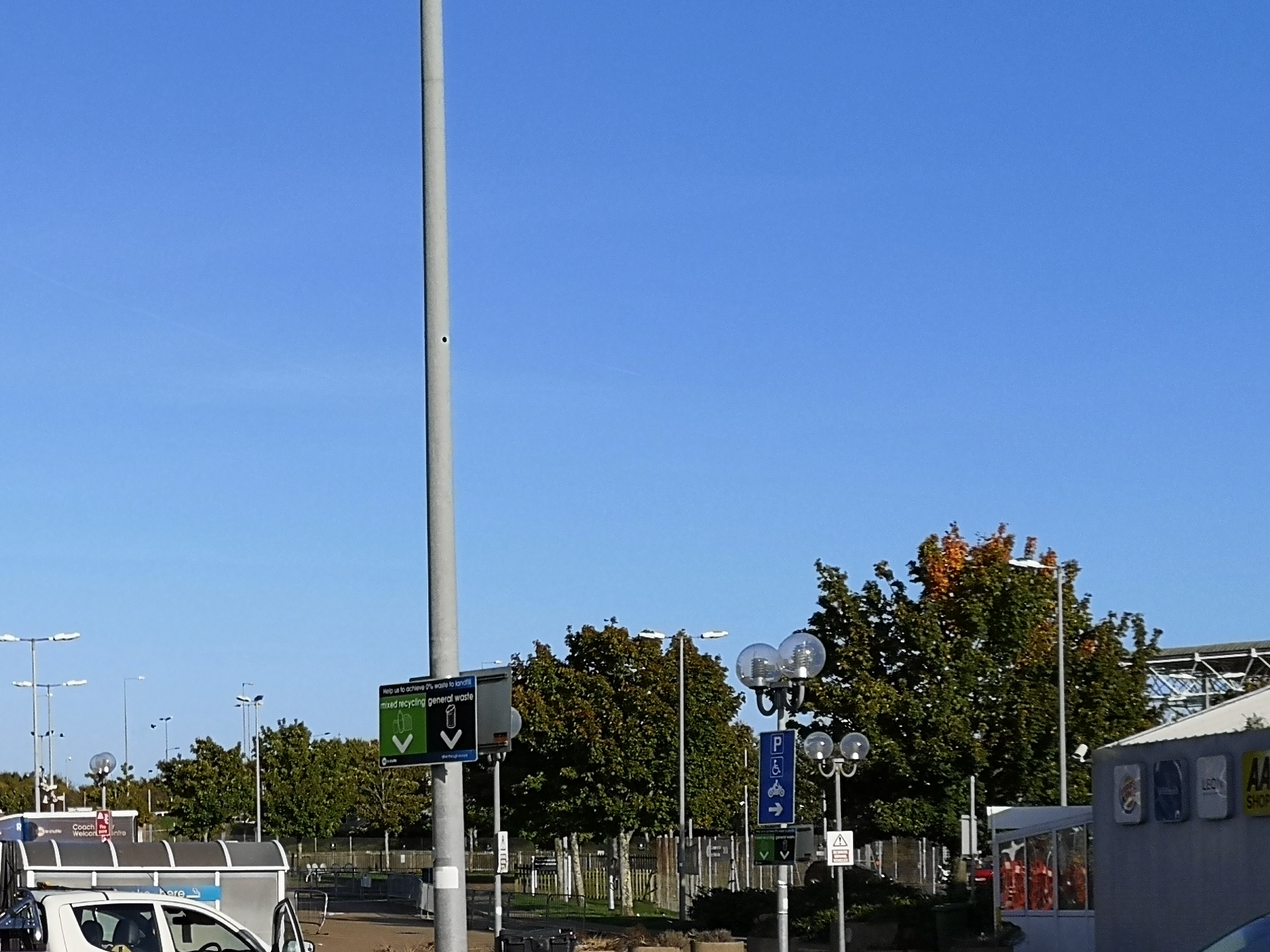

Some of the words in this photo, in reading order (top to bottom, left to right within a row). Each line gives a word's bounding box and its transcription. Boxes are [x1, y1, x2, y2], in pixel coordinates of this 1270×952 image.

[383, 687, 393, 695] Help
[400, 685, 405, 693] to
[406, 684, 425, 693] achieve
[449, 680, 454, 688] to
[381, 700, 397, 708] mixed
[398, 697, 426, 709] recycling
[427, 694, 453, 706] general
[454, 692, 474, 702] waste
[773, 736, 782, 752] P
[72, 823, 95, 831] Coach
